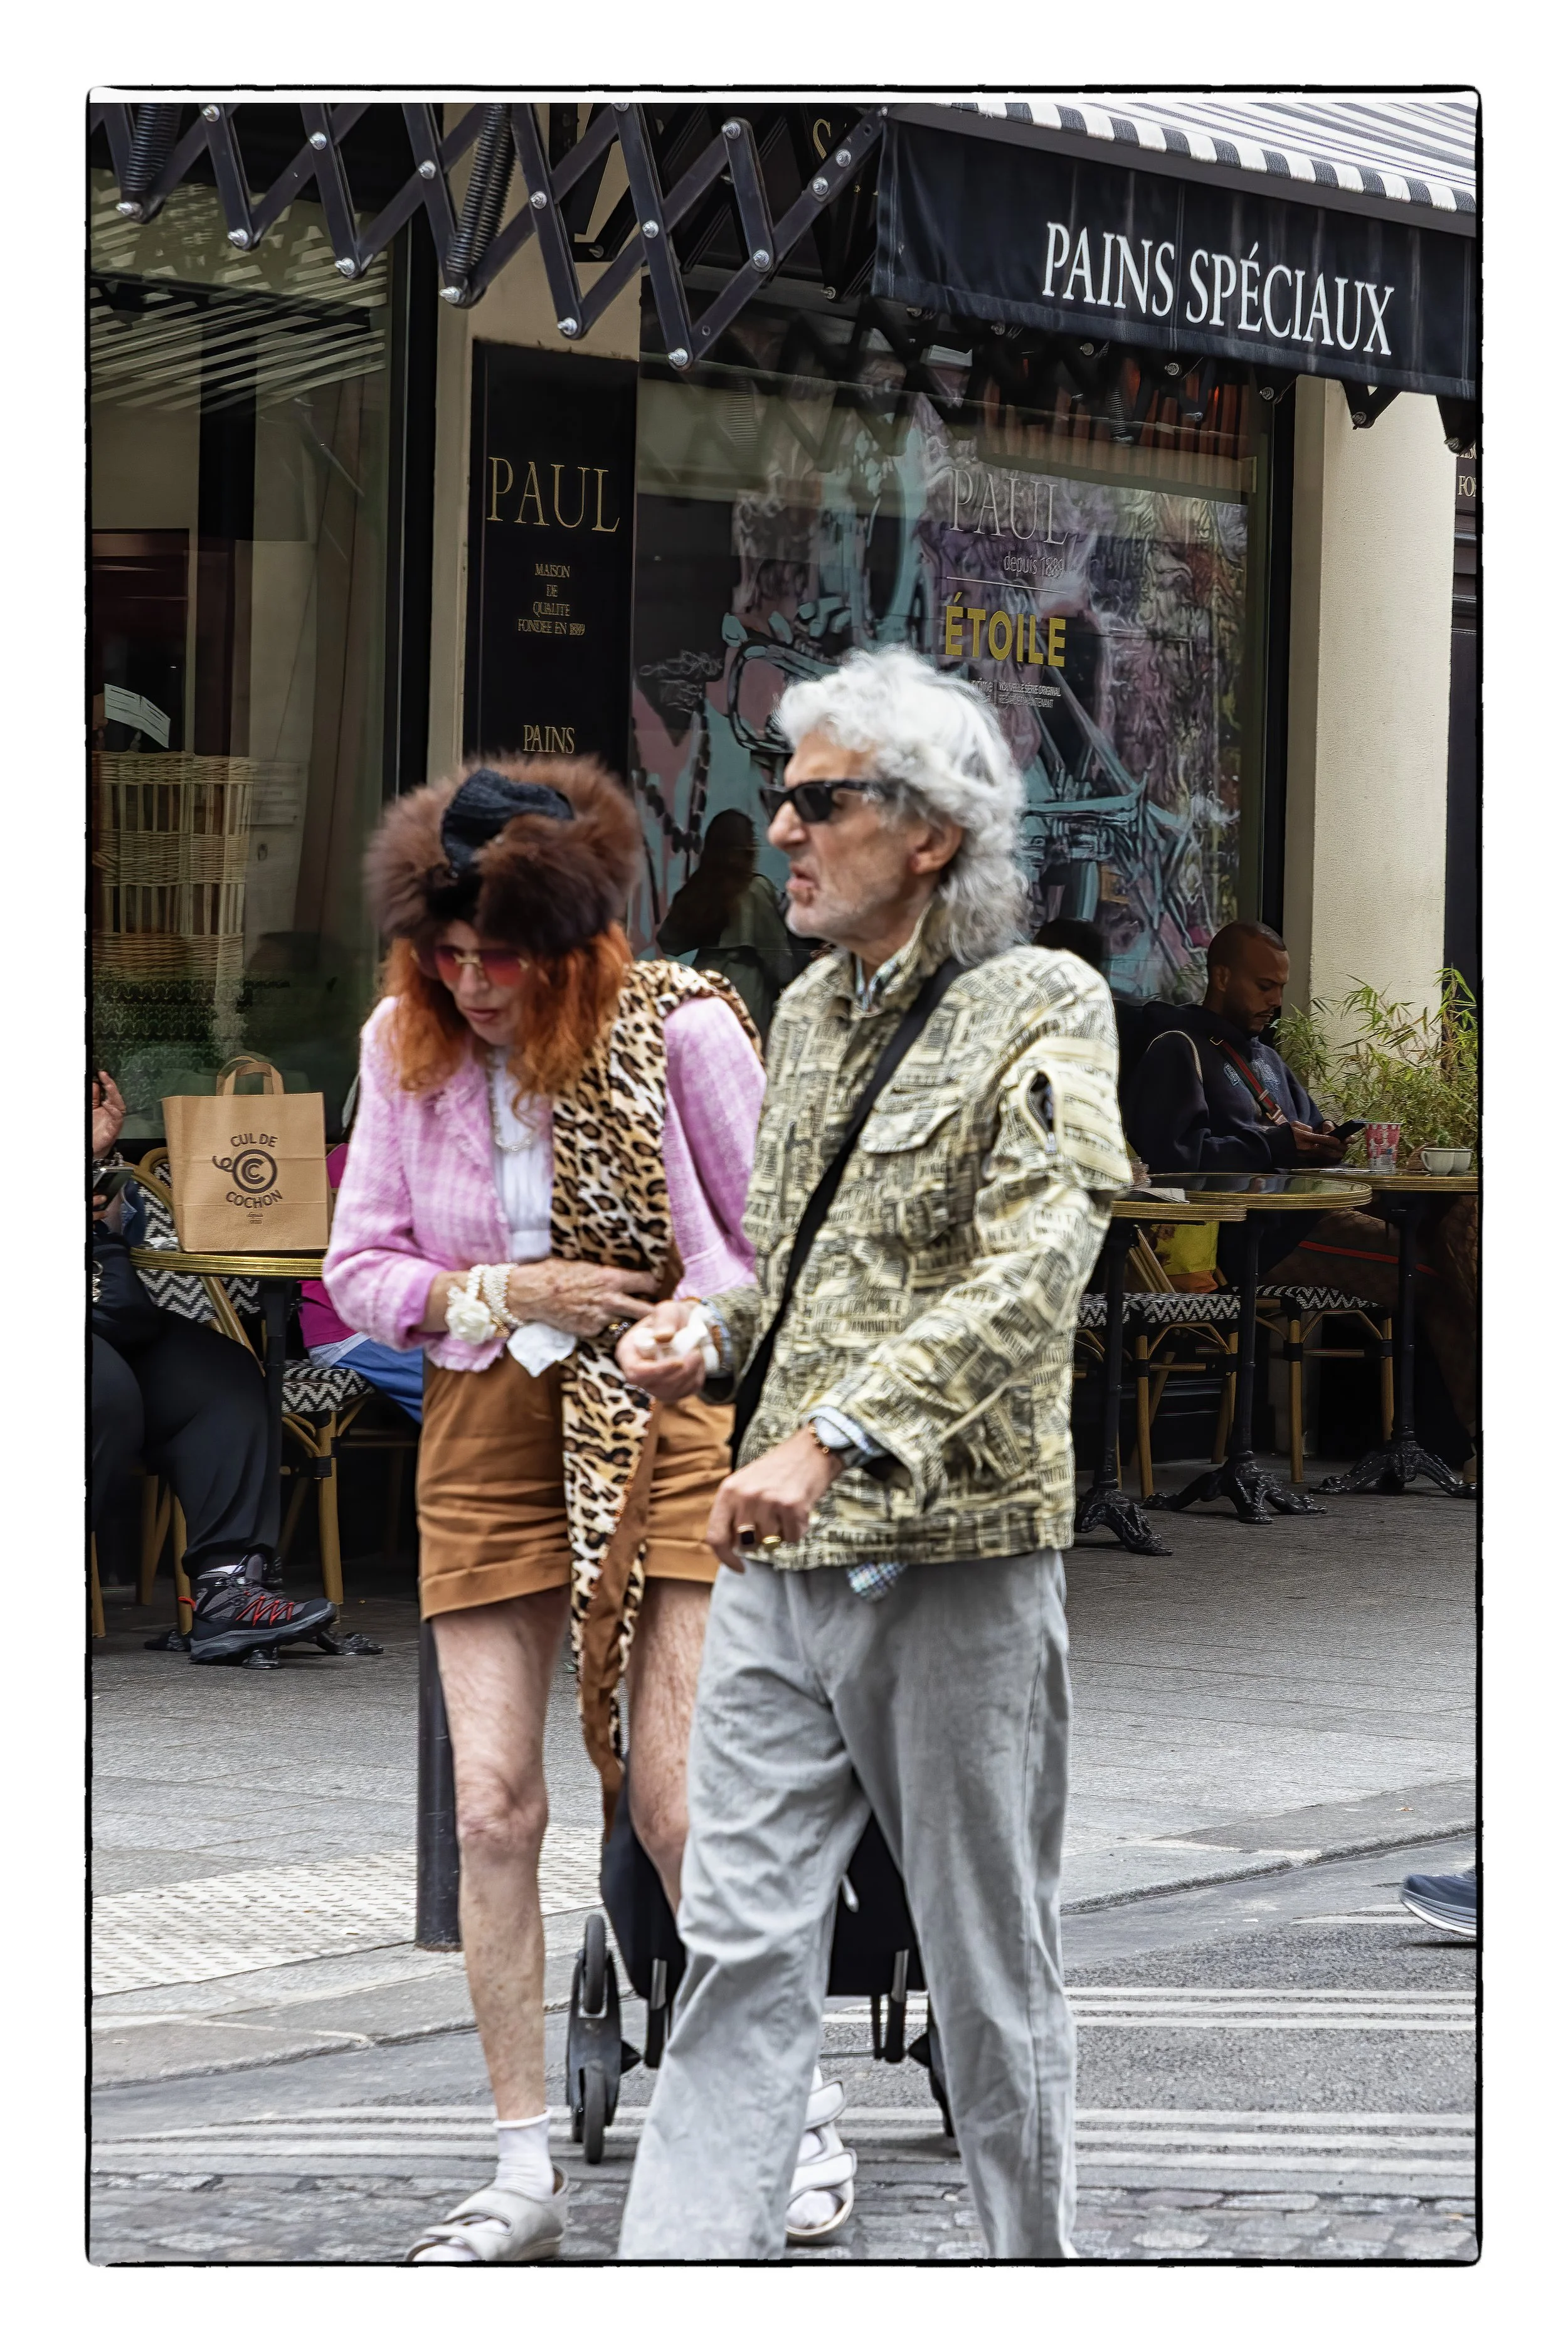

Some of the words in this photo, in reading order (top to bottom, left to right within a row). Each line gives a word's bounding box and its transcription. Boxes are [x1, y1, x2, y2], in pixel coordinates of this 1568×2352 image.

[1042, 221, 1175, 317] PAINS
[1185, 241, 1396, 356] SPÉCIAUX
[486, 457, 620, 532] PAUL
[950, 469, 1069, 544] PAUL
[534, 563, 570, 578] MAISON
[1004, 551, 1037, 576] depuis
[945, 591, 1066, 667] ÉTOILE
[523, 724, 575, 755] PAINS
[230, 1133, 257, 1147] CUL
[259, 1133, 278, 1147] DE
[226, 1189, 283, 1209] COCHON
